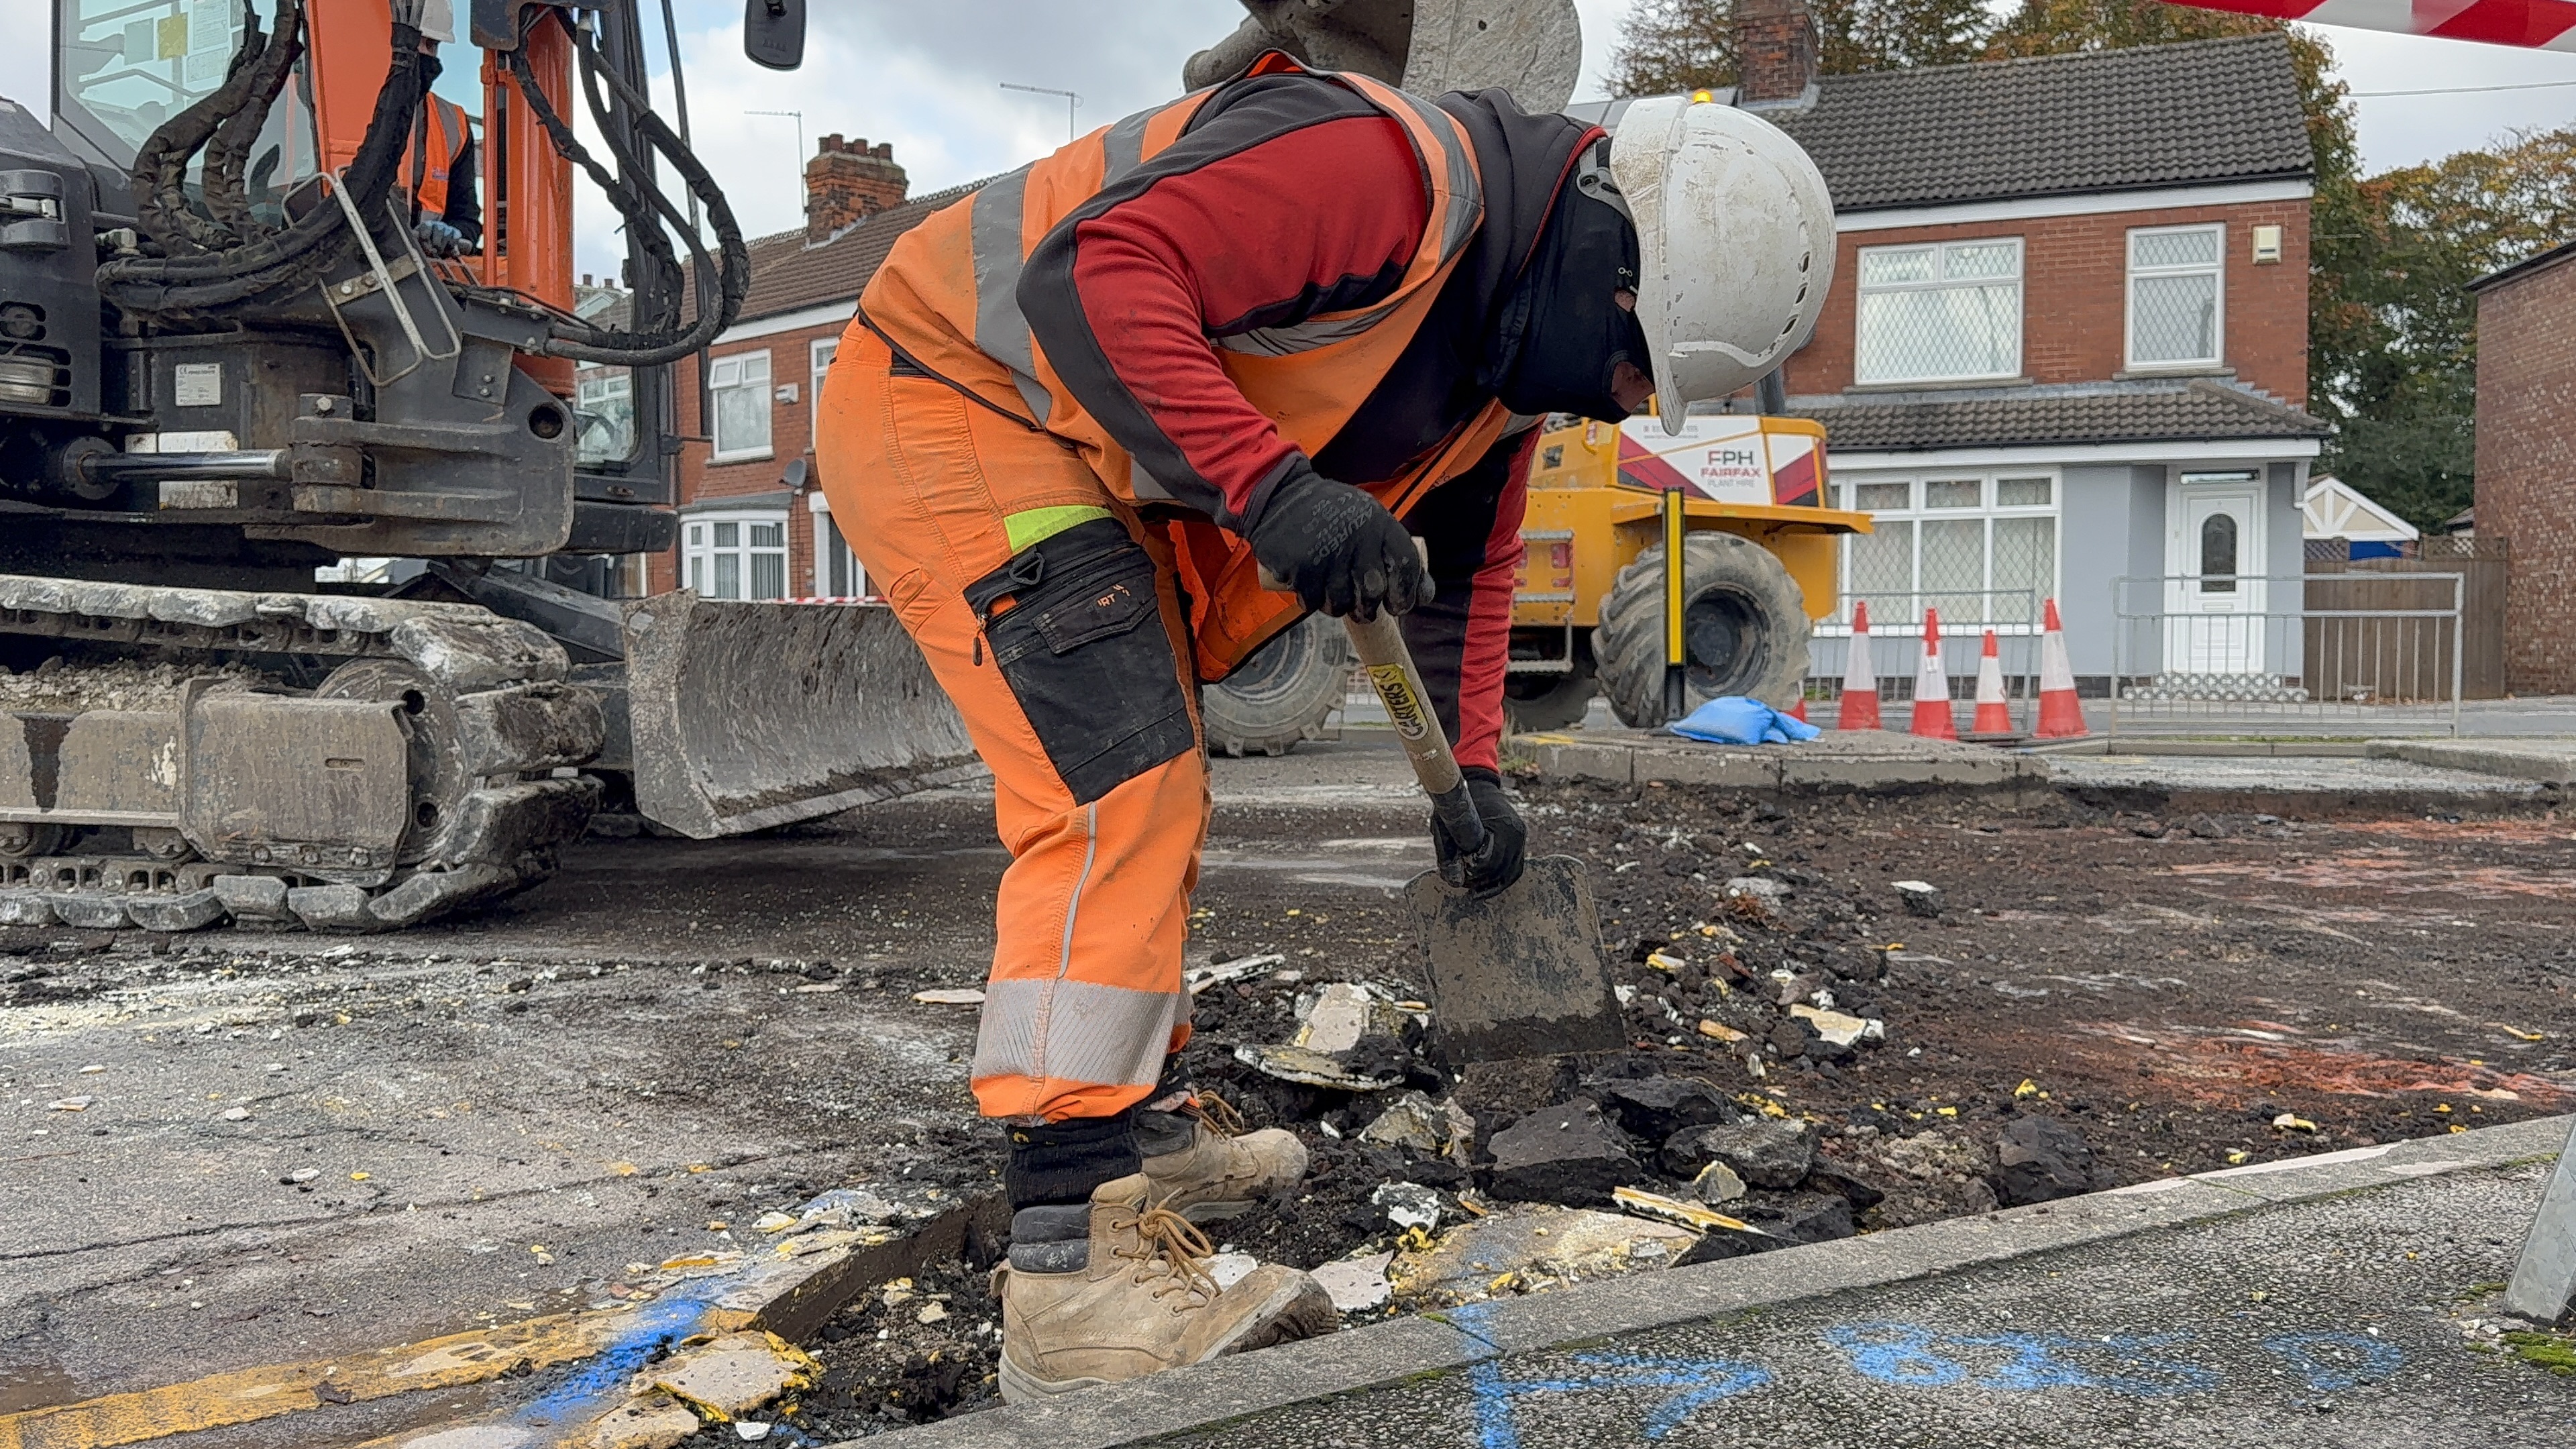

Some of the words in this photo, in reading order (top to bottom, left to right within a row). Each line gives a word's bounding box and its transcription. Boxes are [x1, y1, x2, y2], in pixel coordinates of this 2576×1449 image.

[1700, 467, 1761, 478] FAIRFAX
[1708, 450, 1753, 465] FPH
[1319, 506, 1373, 557] AZURED
[1379, 682, 1424, 737] CARTERS
